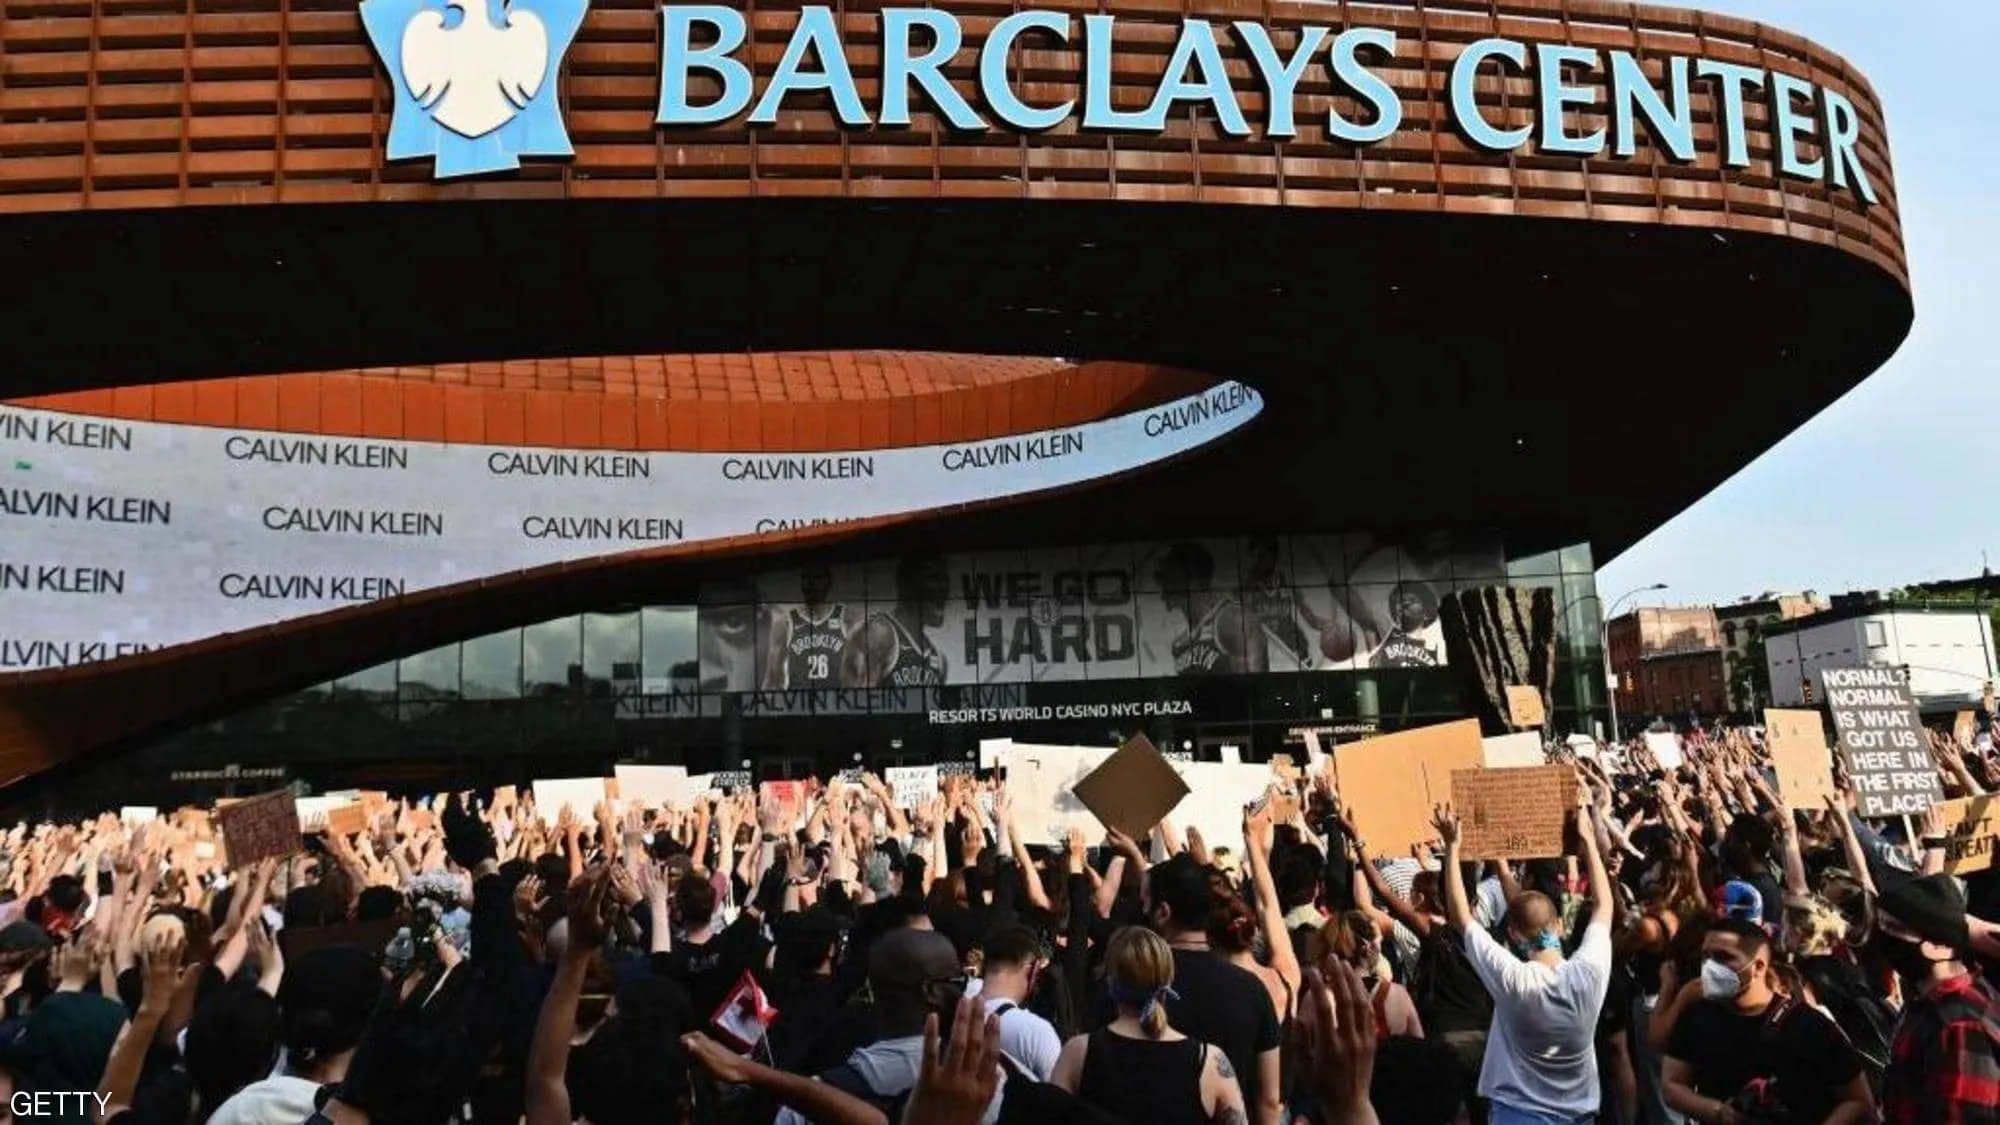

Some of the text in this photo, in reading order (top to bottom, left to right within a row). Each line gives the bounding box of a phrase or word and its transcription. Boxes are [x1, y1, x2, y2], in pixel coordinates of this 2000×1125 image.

[655, 4, 1878, 205] BARCLAYS CENTER
[1143, 383, 1253, 437] CALVIN KLEIN
[0, 413, 132, 451] IN KLEIN
[225, 436, 408, 469] CALVIN KLEIN
[488, 452, 650, 478] CALVIN KLEIN
[942, 432, 1084, 472] CALVIN KLEIN
[722, 457, 874, 481] CALVIN KLEIN
[86, 495, 171, 525] KLEIN
[262, 506, 443, 537] CALVIN KLEIN
[522, 515, 684, 541] CALVIN KLEIN
[38, 565, 125, 595] KLEIN
[219, 573, 405, 601] CALVIN KLEIN
[962, 570, 1131, 609] WE GO
[964, 615, 1134, 665] HARD
[1822, 669, 1907, 687] NORMAL?
[1829, 689, 1908, 706] NORMAL
[929, 700, 1192, 724] RESORTS WORLD CASINO NYC PLAZA
[1837, 710, 1910, 728] IS WHAT
[1846, 731, 1918, 748] GOT US
[1852, 751, 1929, 769] HERE IN
[1851, 772, 1939, 792] THE FIRST
[1866, 793, 1934, 814] PLACE!
